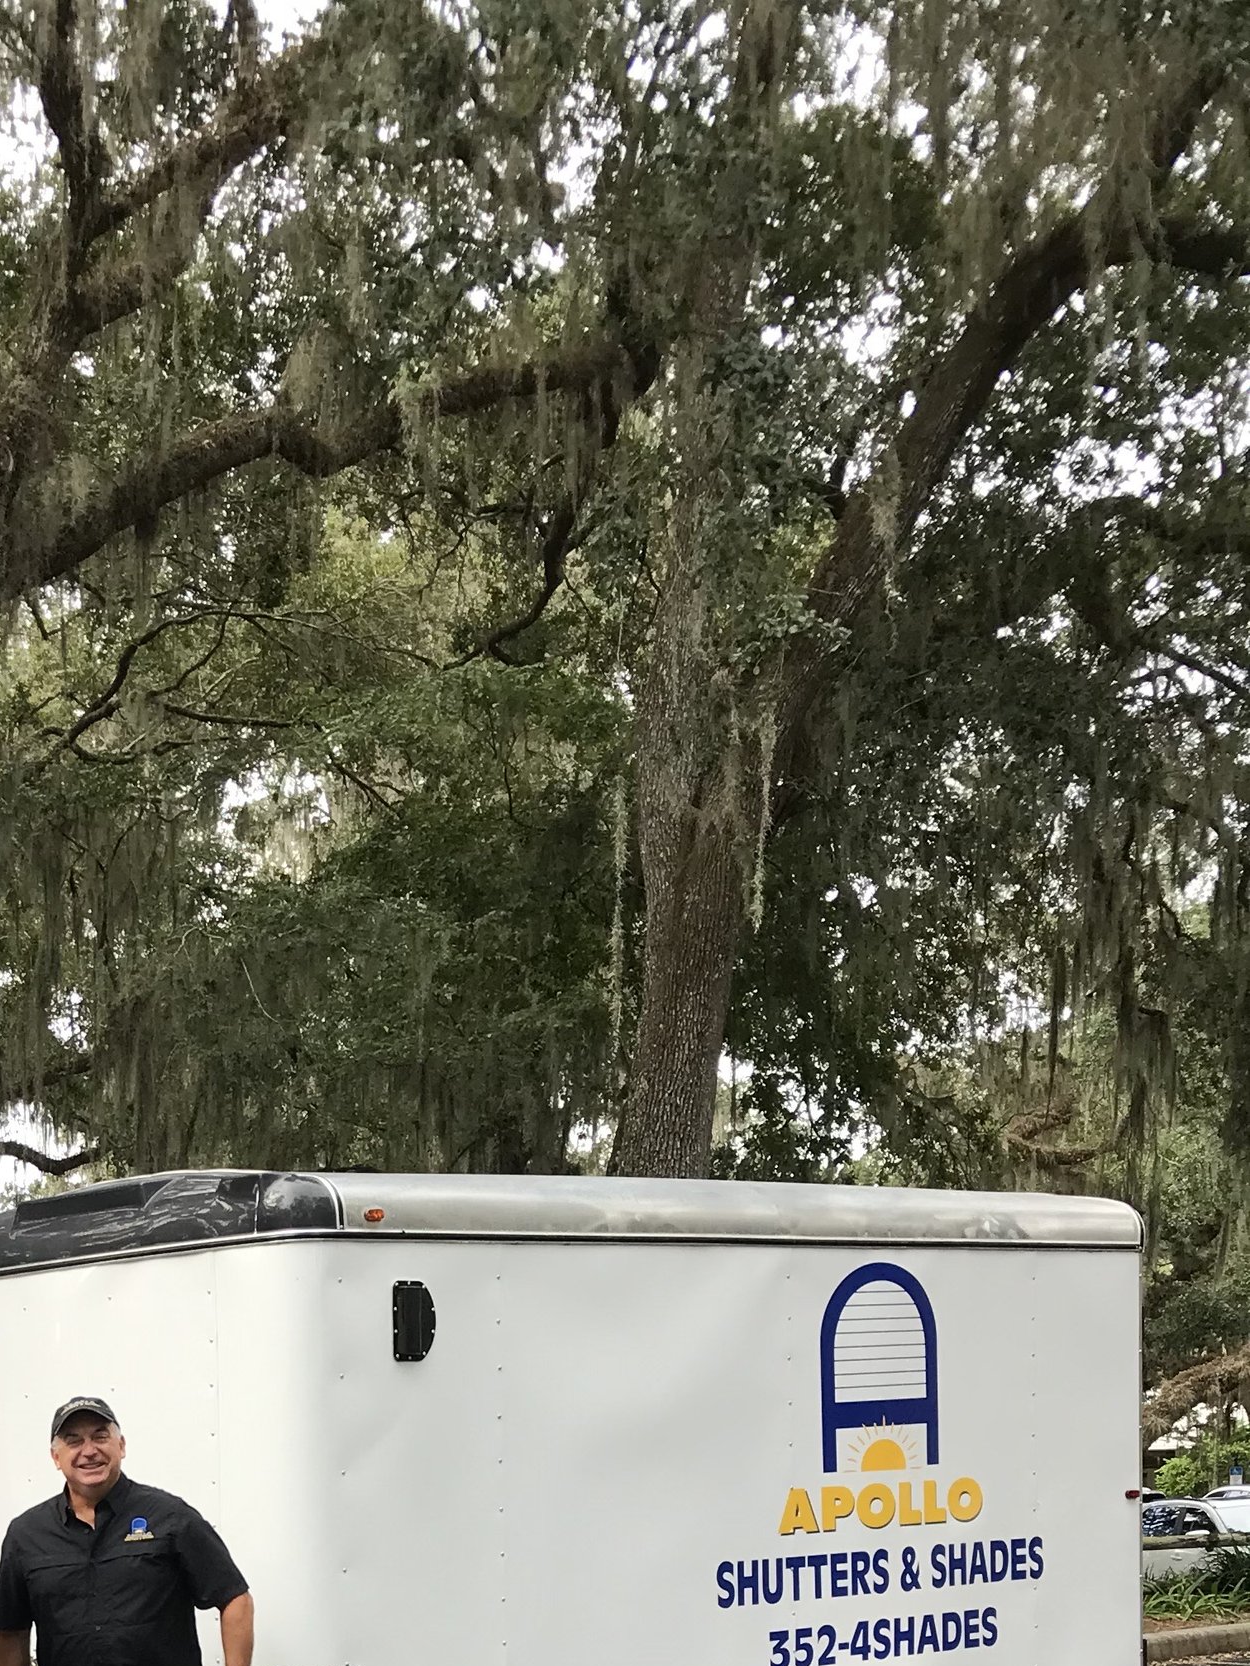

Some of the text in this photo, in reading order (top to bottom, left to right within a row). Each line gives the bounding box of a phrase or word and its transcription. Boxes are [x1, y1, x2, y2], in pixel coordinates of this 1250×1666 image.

[778, 1476, 984, 1536] APOLLO
[716, 1536, 1044, 1609] SHUTTERS & SHADES
